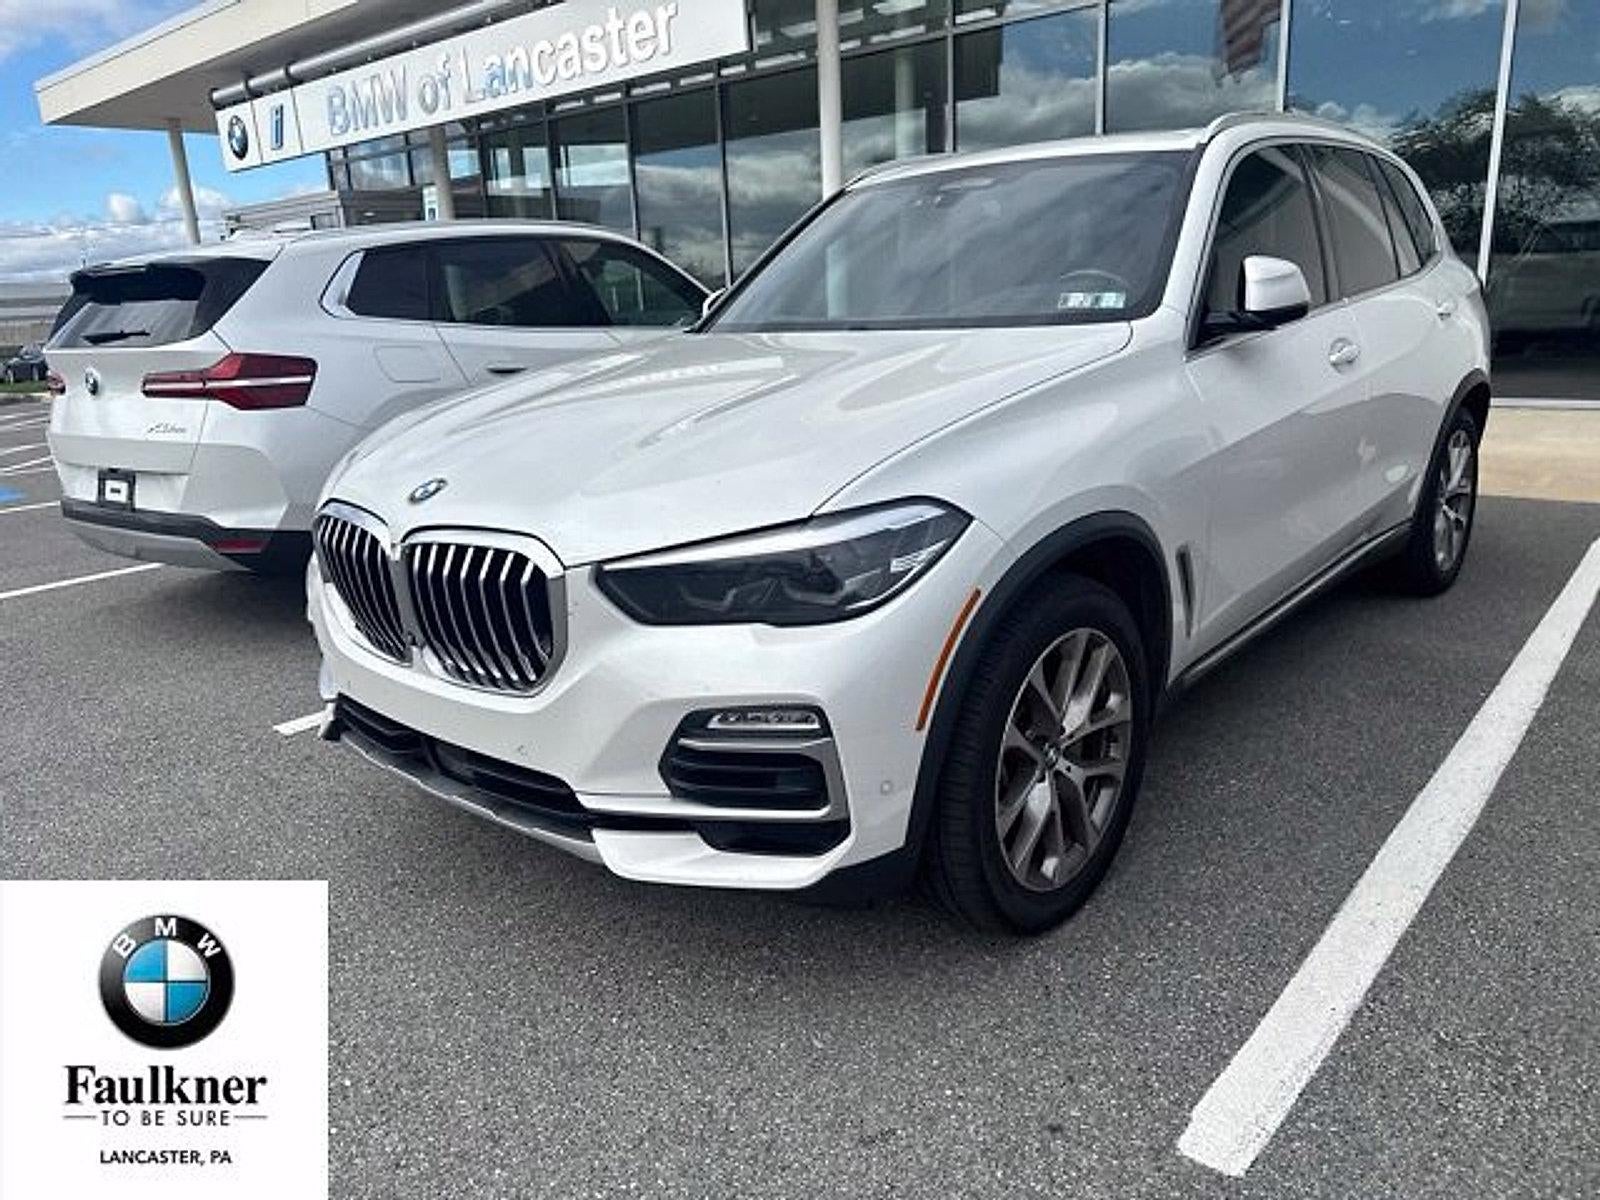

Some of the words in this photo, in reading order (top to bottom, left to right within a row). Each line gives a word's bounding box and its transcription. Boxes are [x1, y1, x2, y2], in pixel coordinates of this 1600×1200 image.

[328, 64, 407, 136] BMW
[418, 53, 452, 115] of
[457, 2, 679, 104] Lancaster
